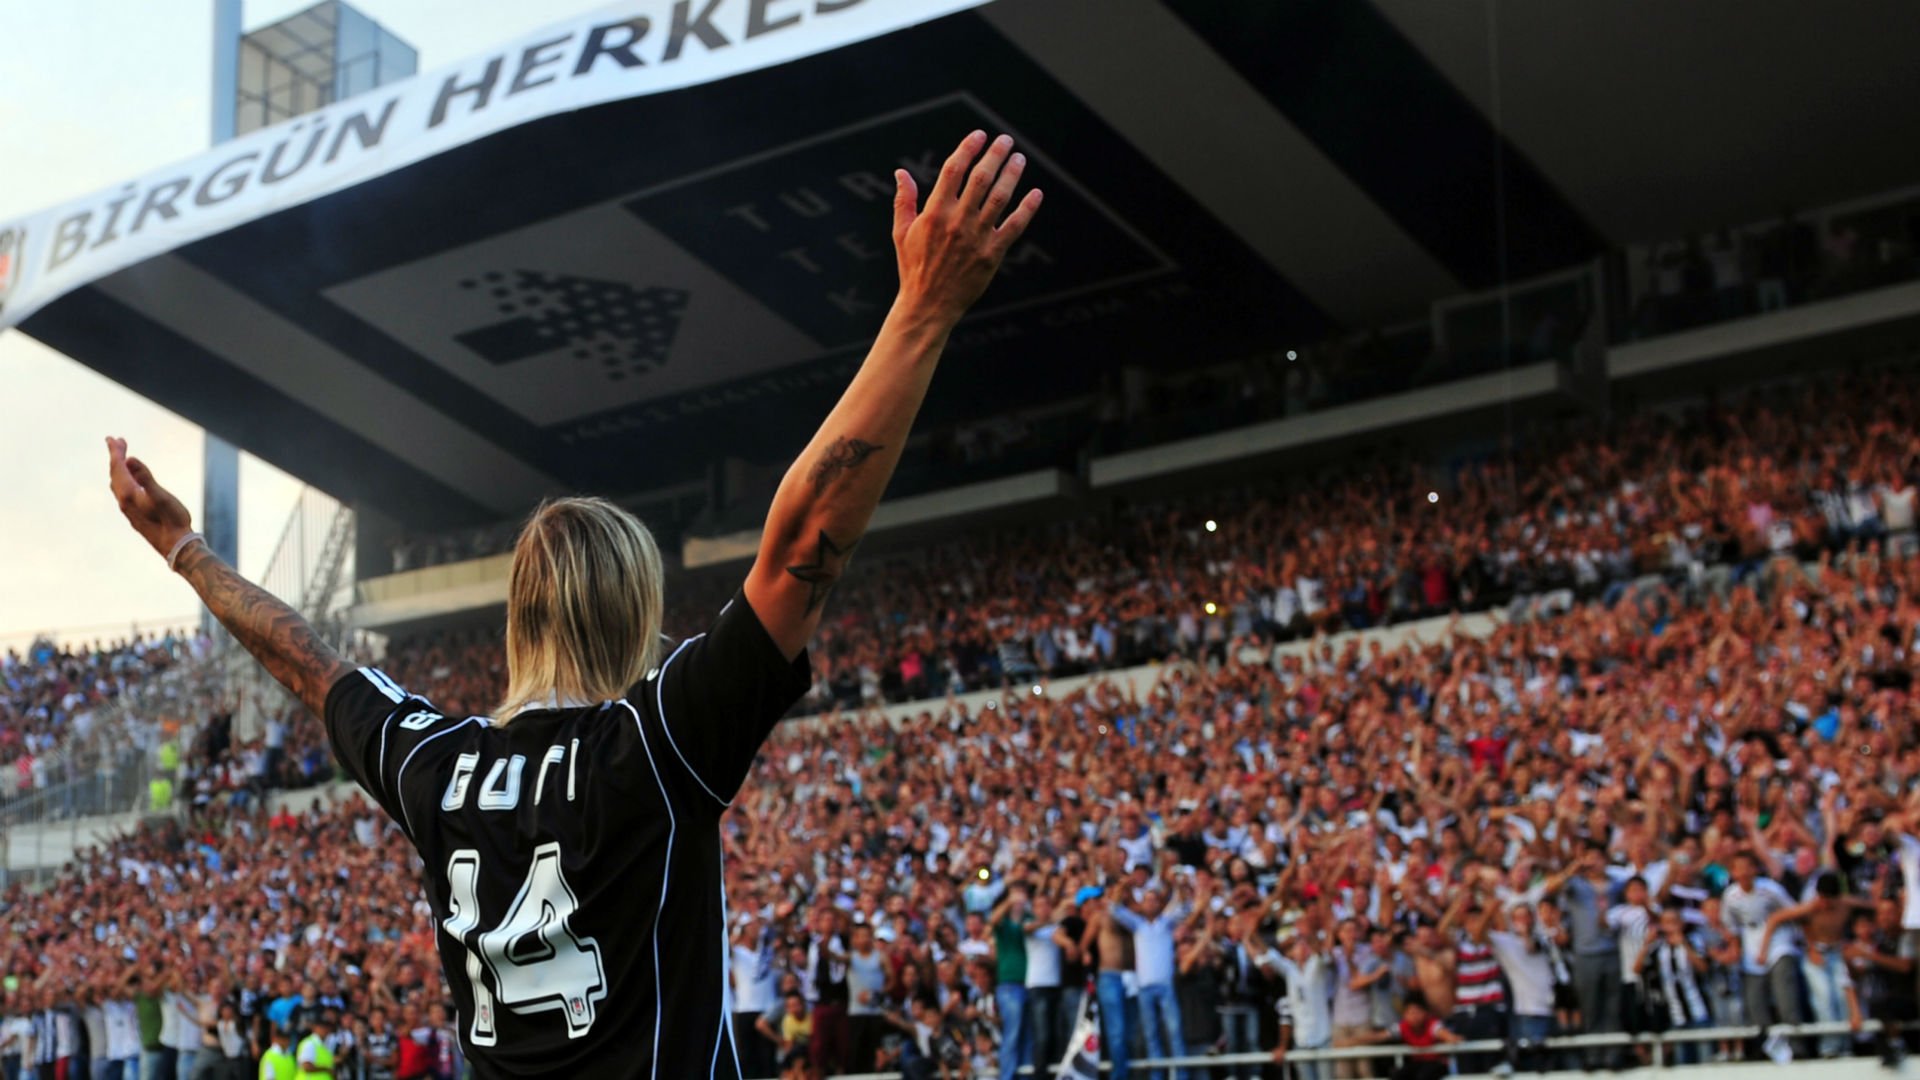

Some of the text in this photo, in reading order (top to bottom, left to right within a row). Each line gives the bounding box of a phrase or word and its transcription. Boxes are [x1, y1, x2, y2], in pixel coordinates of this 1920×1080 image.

[46, 0, 873, 273] BİRGÜN HERKE
[443, 841, 608, 1047] 14
